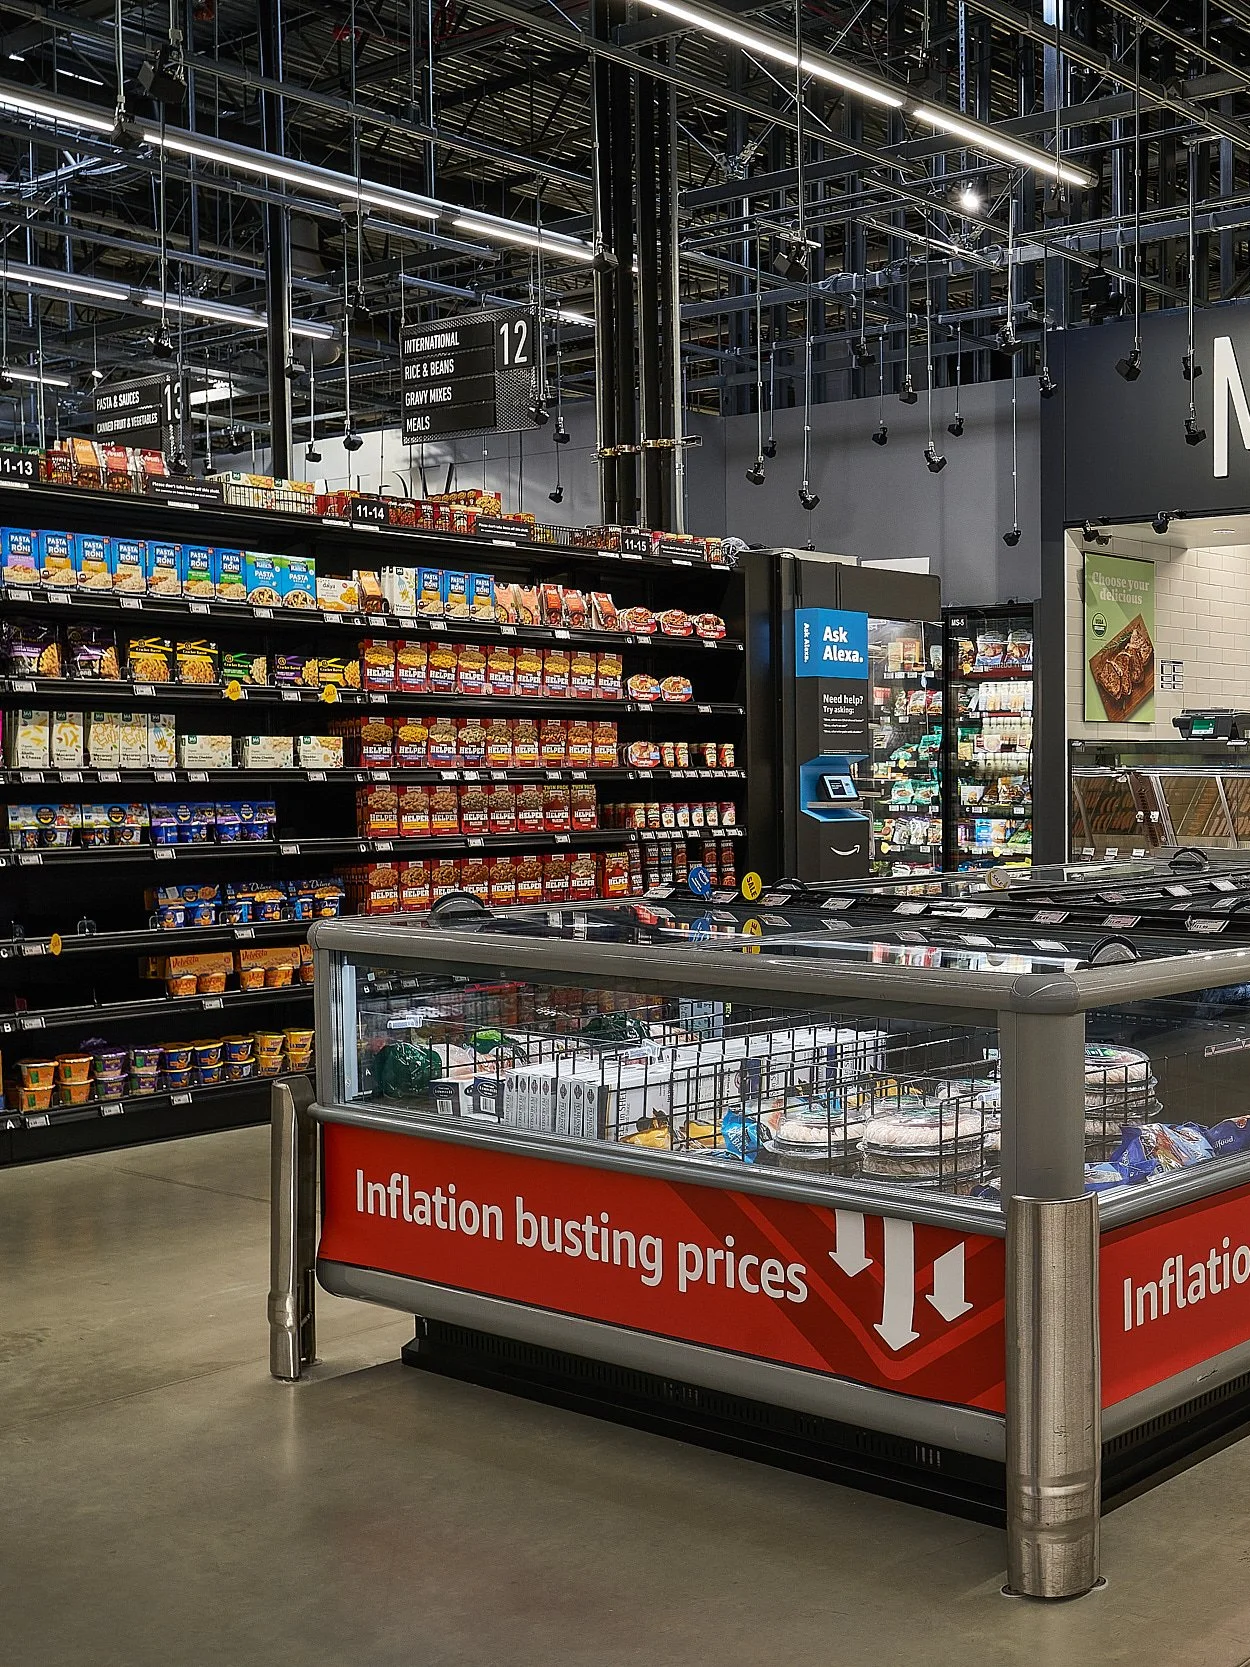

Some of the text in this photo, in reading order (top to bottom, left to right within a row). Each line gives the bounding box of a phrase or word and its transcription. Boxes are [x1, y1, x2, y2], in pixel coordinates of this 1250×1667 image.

[404, 331, 459, 354] INTERNATIONAL
[500, 320, 528, 365] 12
[404, 358, 454, 380] RICE & BEANS
[96, 394, 112, 411] PASTA
[118, 390, 140, 406] SAUCES
[405, 386, 452, 406] GRAVY MIXES
[406, 416, 430, 432] MEALS
[0, 457, 33, 476] 1-13
[356, 504, 384, 520] 11-14
[10, 534, 30, 543] PASTA
[47, 537, 66, 546] PASTA
[11, 543, 30, 552] RONI
[84, 540, 103, 549] PASTA
[120, 544, 138, 553] PASTA
[624, 538, 647, 552] 11-15
[48, 546, 67, 555] RONI
[85, 550, 103, 558] RONI
[156, 548, 174, 557] PASTA
[120, 553, 138, 562] RONI
[157, 556, 174, 564] RONI
[190, 552, 208, 560] PASTA
[223, 554, 240, 563] PASTA
[191, 560, 207, 568] RONI
[223, 563, 240, 571] RONI
[255, 570, 274, 578] PASTA
[1091, 571, 1149, 592] Choose your
[1099, 588, 1143, 605] delicious
[823, 626, 848, 643] Ask
[822, 645, 864, 663] Alexa.
[367, 668, 394, 678] HELPER
[399, 669, 426, 678] HELPER
[430, 672, 455, 680] HELPER
[460, 672, 485, 681] HELPER
[490, 674, 513, 682] HELPER
[517, 675, 540, 683] HELPER
[545, 676, 568, 685] HELPER
[572, 677, 595, 686] HELPER
[599, 678, 620, 686] HELPER
[823, 694, 863, 706] Need help?
[823, 706, 855, 715] Try asking:
[363, 746, 392, 754] HELPER
[399, 746, 426, 754] HELPER
[430, 745, 456, 753] HELPER
[487, 746, 512, 754] HELPER
[515, 746, 538, 754] HELPER
[542, 745, 565, 754] HELPER
[569, 746, 592, 754] HELPER
[595, 746, 616, 754] HELPER
[370, 813, 397, 822] HELPER
[402, 814, 429, 823] HELPER
[432, 813, 457, 822] HELPER
[464, 812, 488, 821] HELPER
[491, 812, 515, 820] HELPER
[519, 811, 543, 820] HELPER
[545, 811, 568, 819] HELPER
[574, 810, 596, 818] HELPER
[518, 882, 542, 890] HELPER
[546, 880, 568, 888] HELPER
[571, 878, 594, 887] HELPER
[746, 876, 758, 898] SALE
[492, 884, 516, 892] HELPER
[371, 891, 397, 899] HELPER
[402, 889, 429, 898] HELPER
[0, 948, 8, 958] C
[4, 1023, 11, 1032] B
[6, 1119, 15, 1129] A
[355, 1168, 808, 1303] Inflation busting prices
